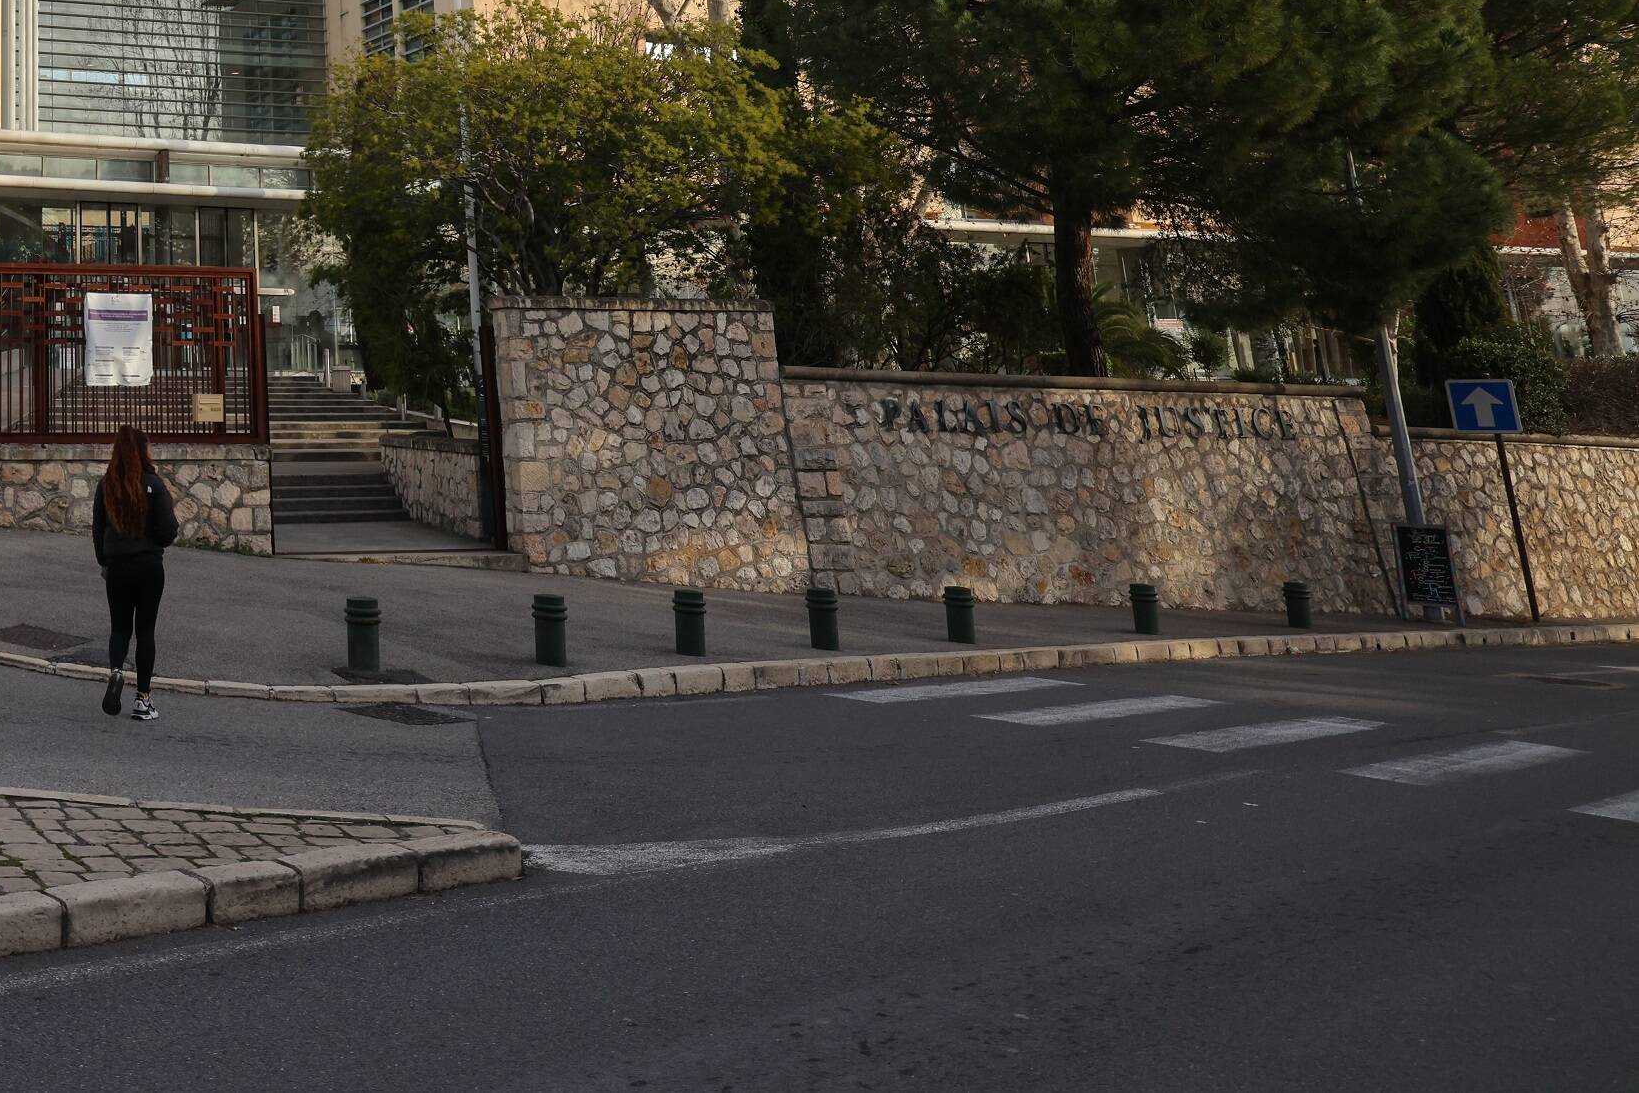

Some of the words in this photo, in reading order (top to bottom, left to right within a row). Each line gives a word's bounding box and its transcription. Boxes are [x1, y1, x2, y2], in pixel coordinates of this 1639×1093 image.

[879, 397, 1028, 435] PALAIS
[1052, 403, 1106, 436] DE
[1138, 405, 1297, 444] JUSTICE
